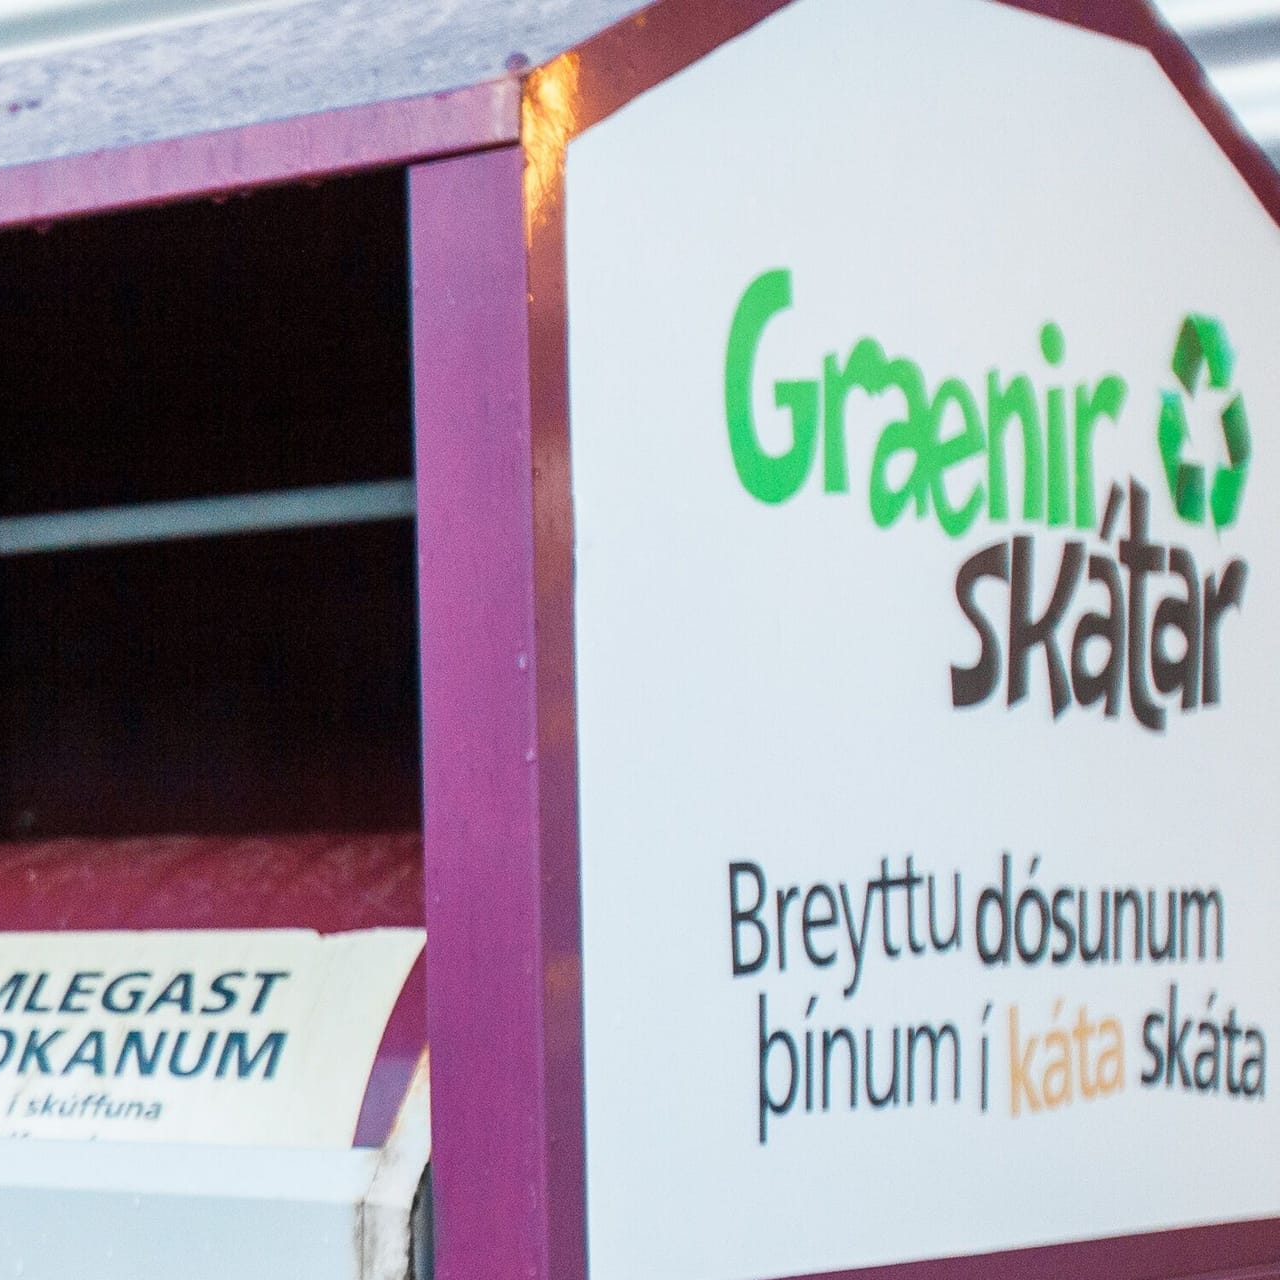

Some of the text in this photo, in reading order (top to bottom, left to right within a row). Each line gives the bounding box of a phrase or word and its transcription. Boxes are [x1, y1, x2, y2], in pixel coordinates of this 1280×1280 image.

[728, 850, 1225, 998] Breyttu dósunum
[26, 1092, 164, 1122] skúffuna
[758, 979, 1268, 1145] þínum í káta skáta
